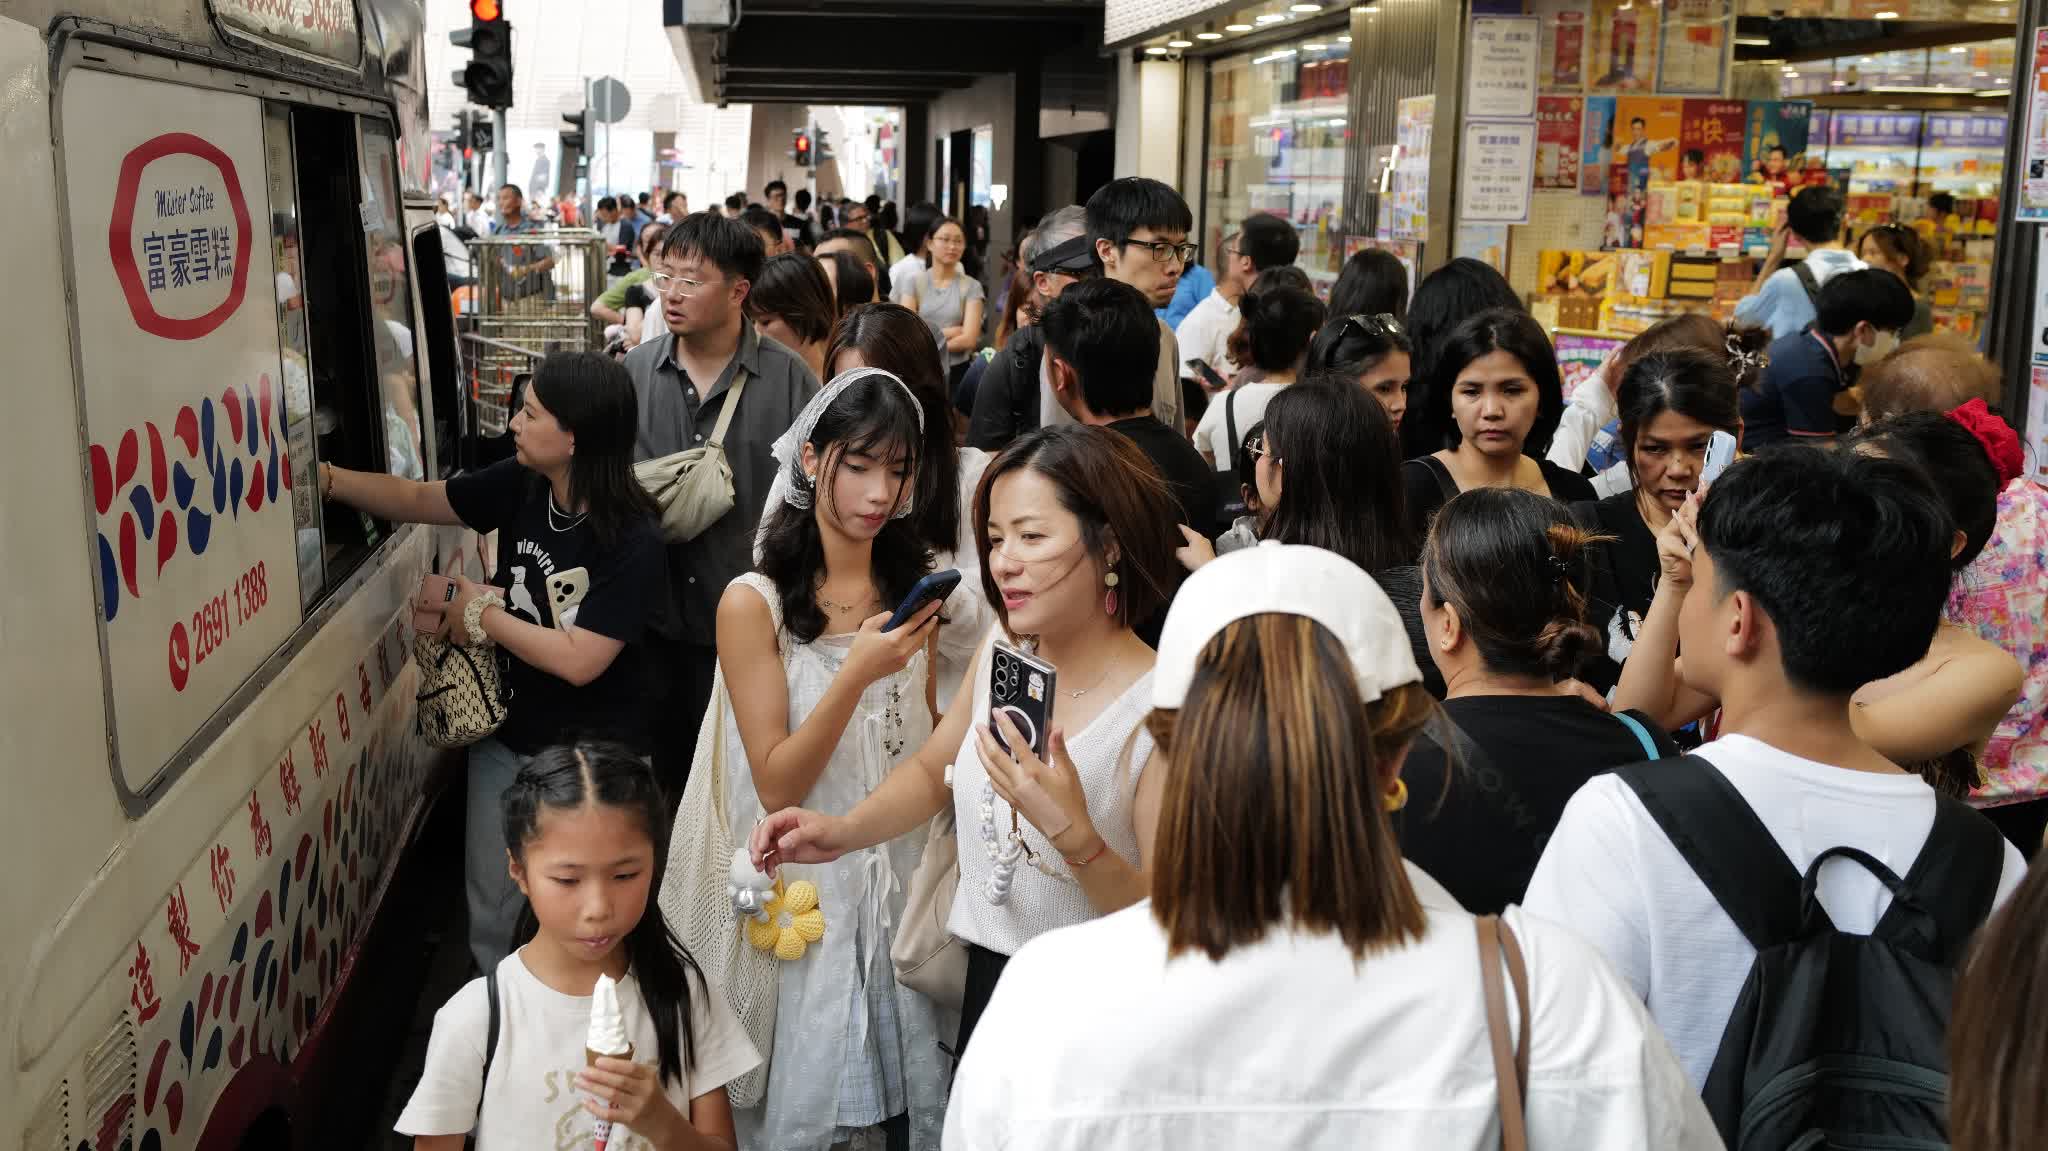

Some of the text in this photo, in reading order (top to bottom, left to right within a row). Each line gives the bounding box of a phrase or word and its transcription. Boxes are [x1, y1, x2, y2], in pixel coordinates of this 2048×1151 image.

[155, 185, 214, 219] Mister Softee
[143, 226, 233, 293] 富豪雪糕
[192, 560, 268, 665] 2691 1388
